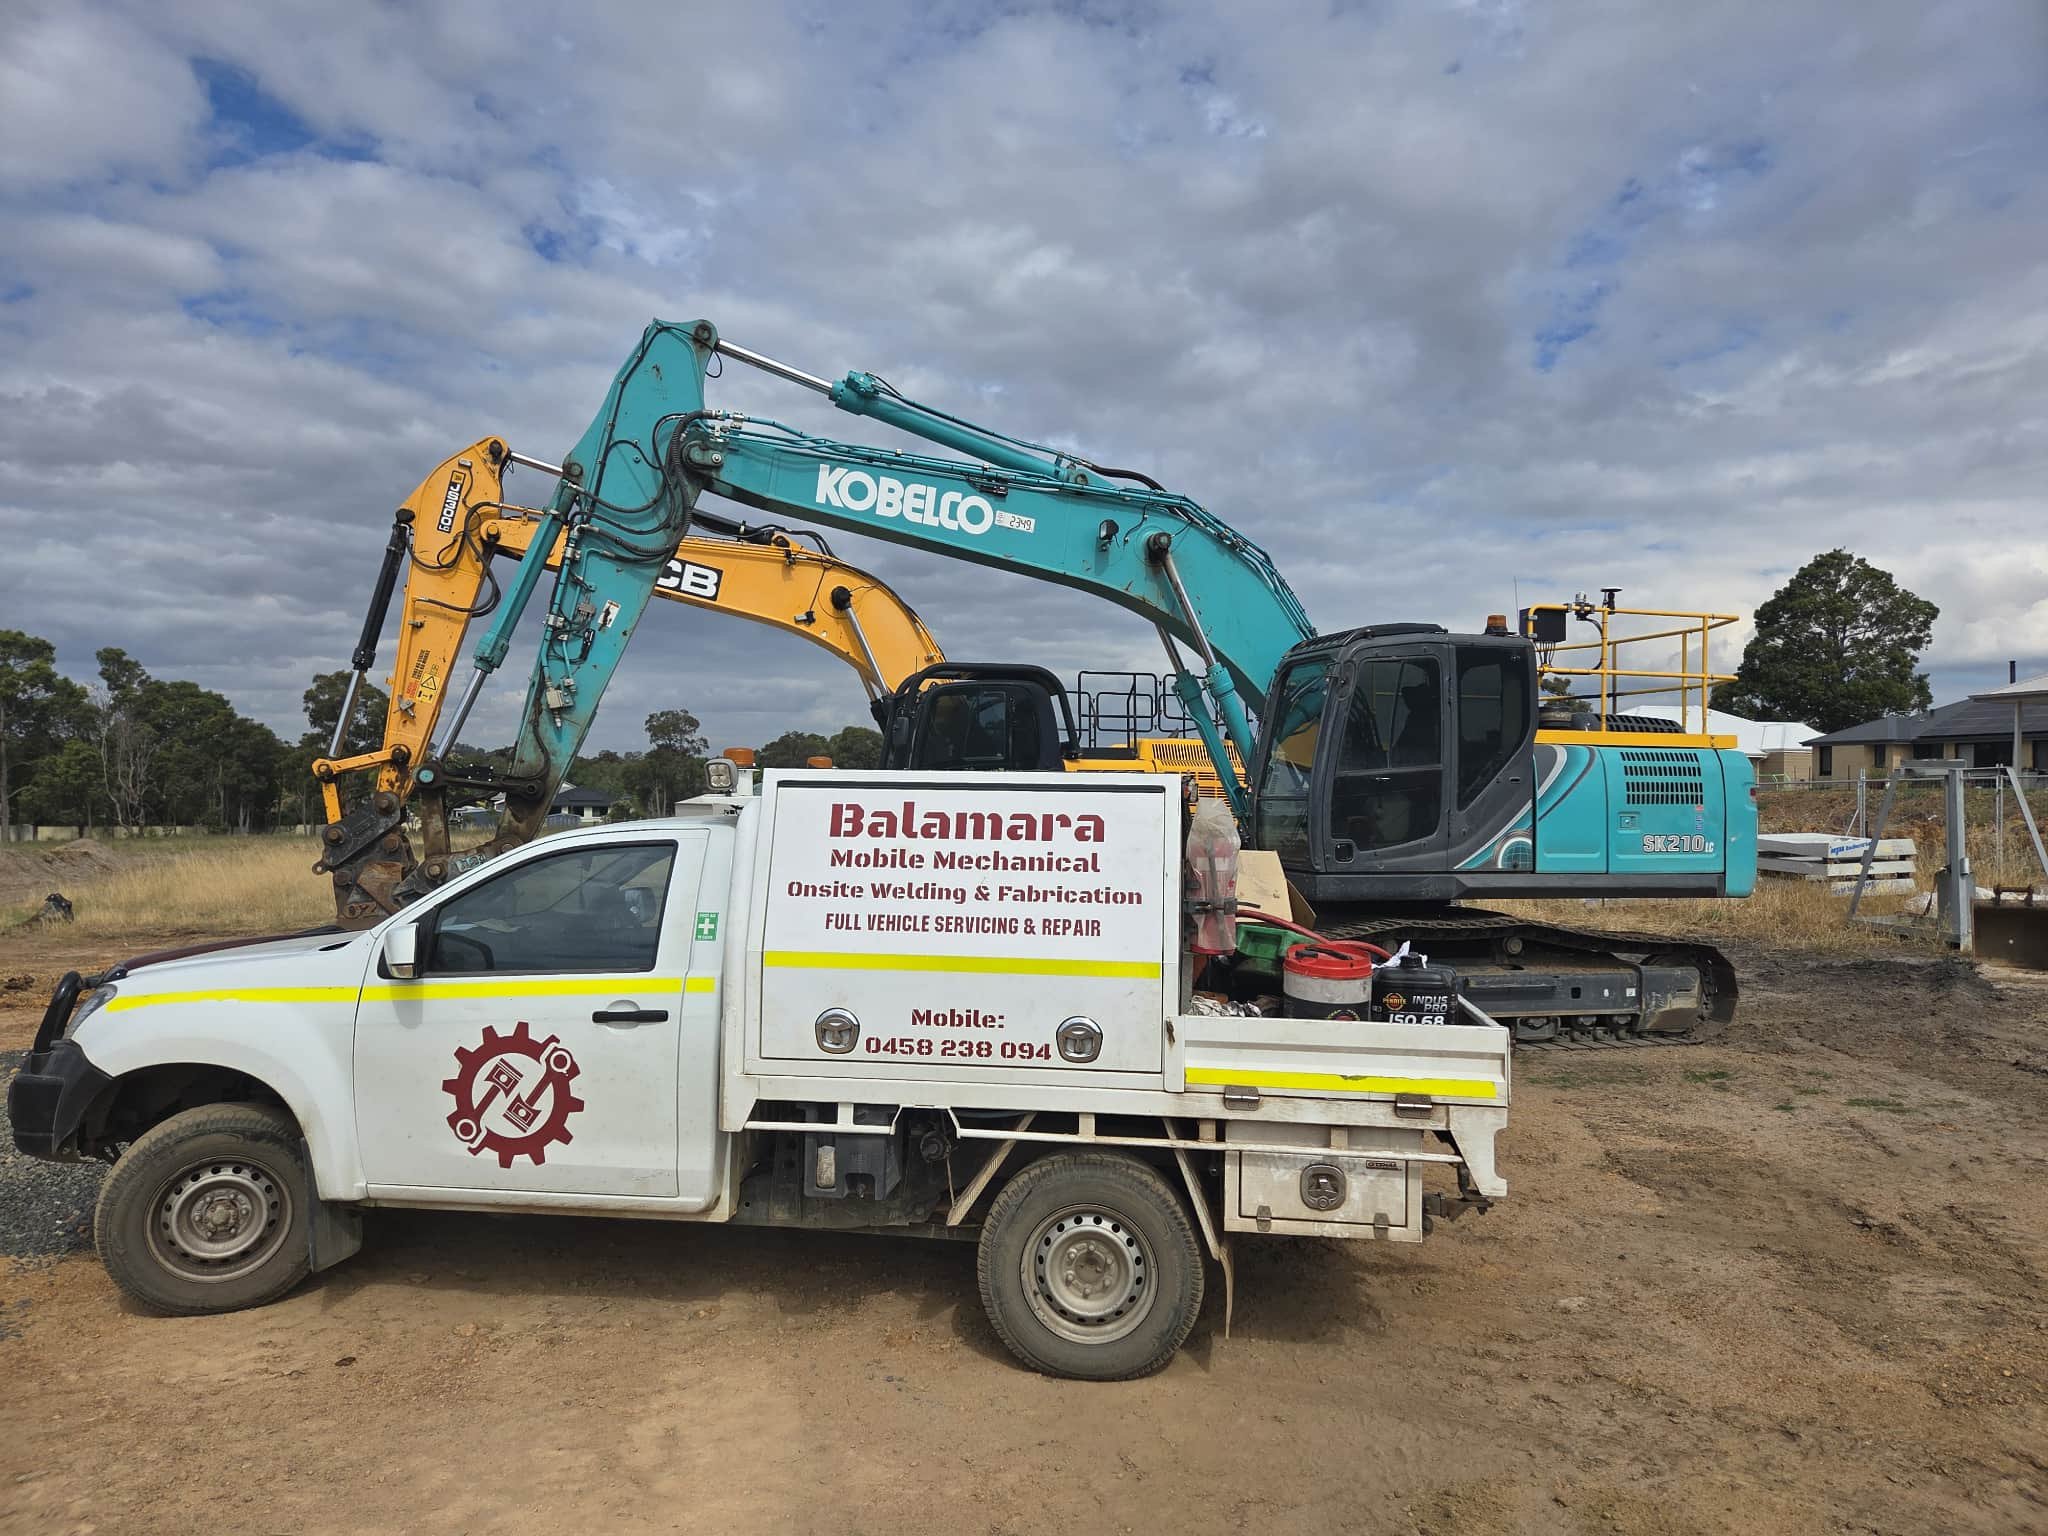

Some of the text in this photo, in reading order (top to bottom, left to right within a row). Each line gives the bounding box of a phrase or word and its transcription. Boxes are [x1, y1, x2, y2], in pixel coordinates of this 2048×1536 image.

[815, 463, 994, 535] KOBELCO
[656, 559, 719, 598] CB
[829, 801, 1105, 843] Balamara
[830, 848, 1101, 873] Mobile Mechanical
[787, 880, 1142, 905] Onsite Welding & Fabrication
[825, 912, 1101, 937] FULL VEHICLE SERVICING & REPAIR
[1412, 995, 1448, 1005] INDUS
[1423, 1003, 1448, 1013] PRO
[911, 1008, 1005, 1029] Mobile:
[865, 1036, 1053, 1061] 0458 238 094
